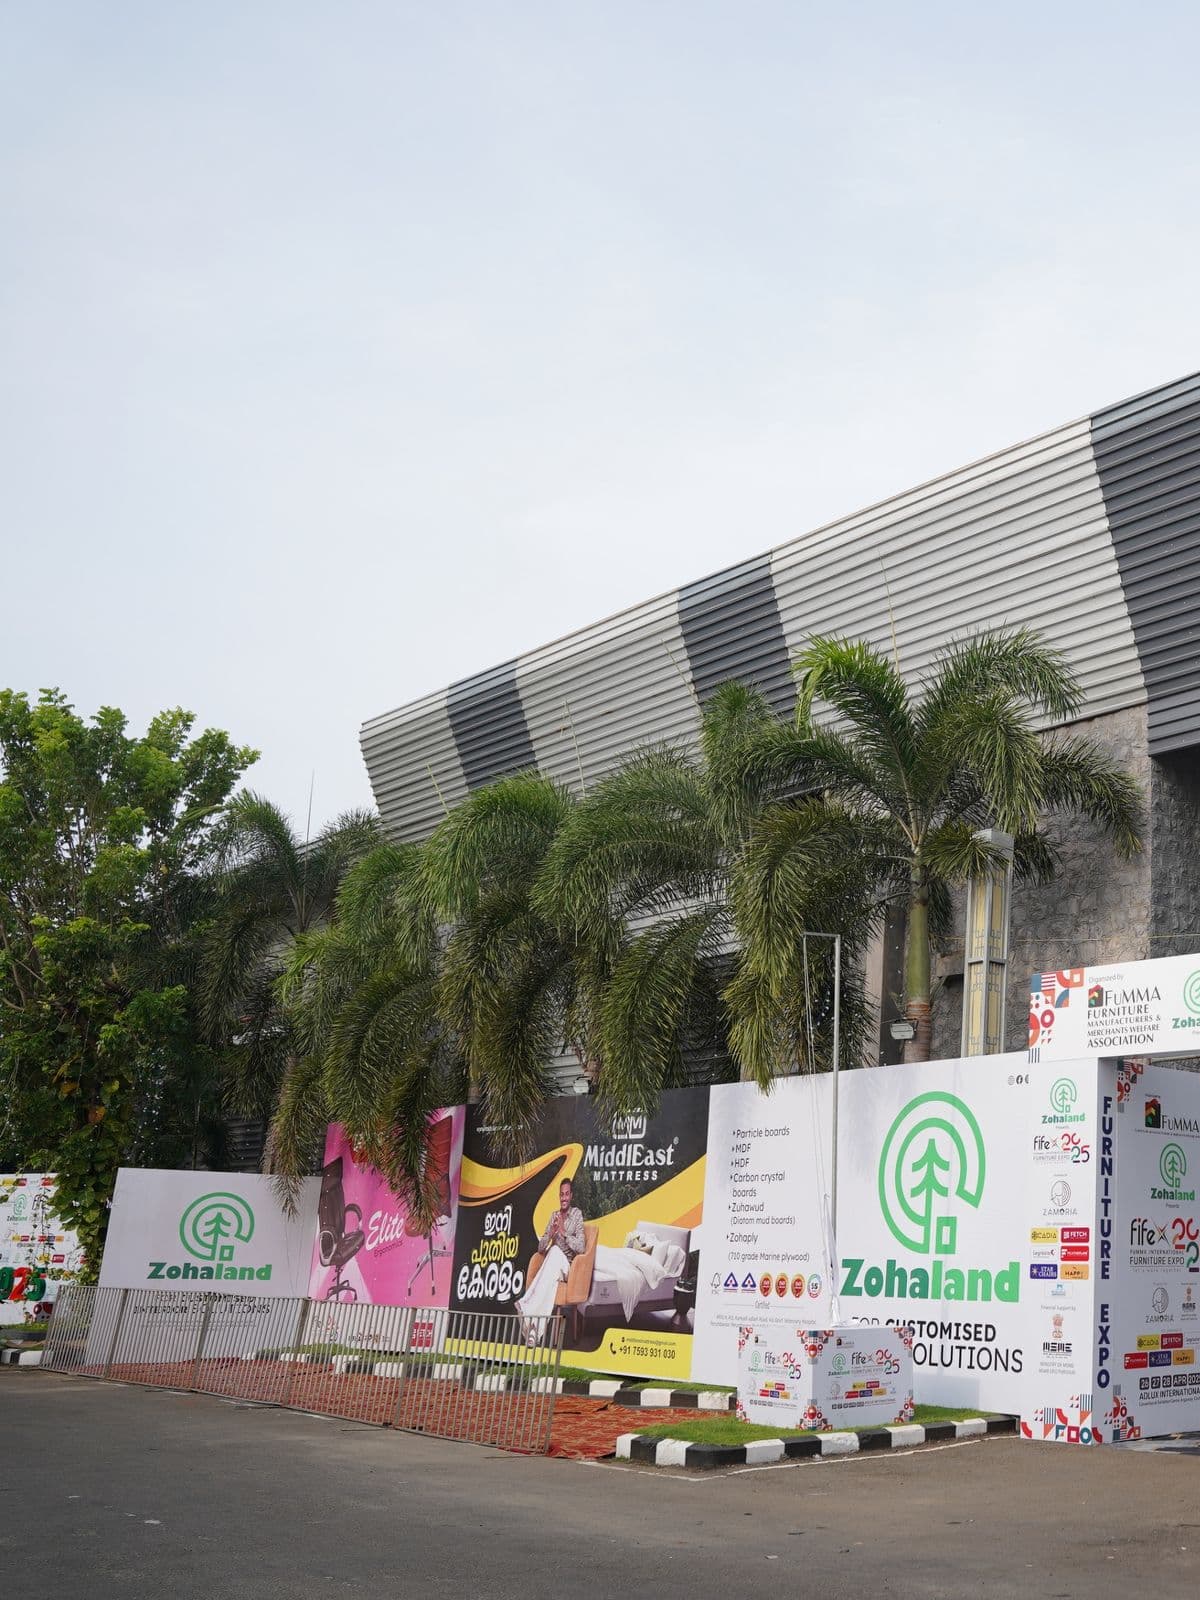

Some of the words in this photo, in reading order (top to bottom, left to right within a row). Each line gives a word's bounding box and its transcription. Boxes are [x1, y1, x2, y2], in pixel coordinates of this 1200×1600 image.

[1088, 1004, 1149, 1020] FURNITURE
[1088, 1014, 1152, 1028] MANUFACTURERS
[1088, 1025, 1128, 1037] MERCHANTS
[1129, 1023, 1160, 1034] WELFARE
[1087, 1034, 1154, 1048] ASSOCIATION
[1041, 1113, 1086, 1124] Zohaland
[736, 1128, 762, 1139] Particle
[764, 1126, 790, 1137] boards
[735, 1143, 751, 1153] MDF
[583, 1144, 675, 1167] MiddlEast
[734, 1158, 750, 1168] HDF
[593, 1170, 658, 1181] MATTRESS
[733, 1172, 759, 1182] Carbon
[760, 1171, 785, 1184] crystal
[732, 1188, 757, 1198] boards
[1100, 1096, 1113, 1280] FURNITURE
[1150, 1187, 1195, 1201] Zohaland
[731, 1202, 764, 1212] Zuhawud
[1042, 1207, 1078, 1216] ZAMORIA
[484, 1204, 513, 1236] ഇനി
[756, 1216, 769, 1225] mud
[771, 1216, 796, 1225] boards)
[366, 1210, 404, 1250] Elite
[729, 1232, 758, 1244] Zohaply
[471, 1231, 519, 1269] പുതിയ
[741, 1253, 758, 1262] grade
[760, 1252, 780, 1261] Marine
[781, 1253, 810, 1262] plywood)
[1129, 1256, 1166, 1265] FURNITURE
[1168, 1256, 1185, 1265] EXPO
[147, 1262, 272, 1281] Zohaland
[457, 1261, 524, 1303] കേരളം
[840, 1259, 1021, 1303] Zohaland
[1145, 1314, 1175, 1323] ZAMORIA
[619, 1346, 631, 1355] +91
[633, 1346, 648, 1357] 7593
[650, 1348, 661, 1358] 931
[663, 1349, 676, 1359] 030
[1097, 1304, 1111, 1389] EXPO
[913, 1343, 1023, 1373] OLUTIONS
[1173, 1375, 1187, 1386] APR
[1139, 1391, 1159, 1400] ADLUX
